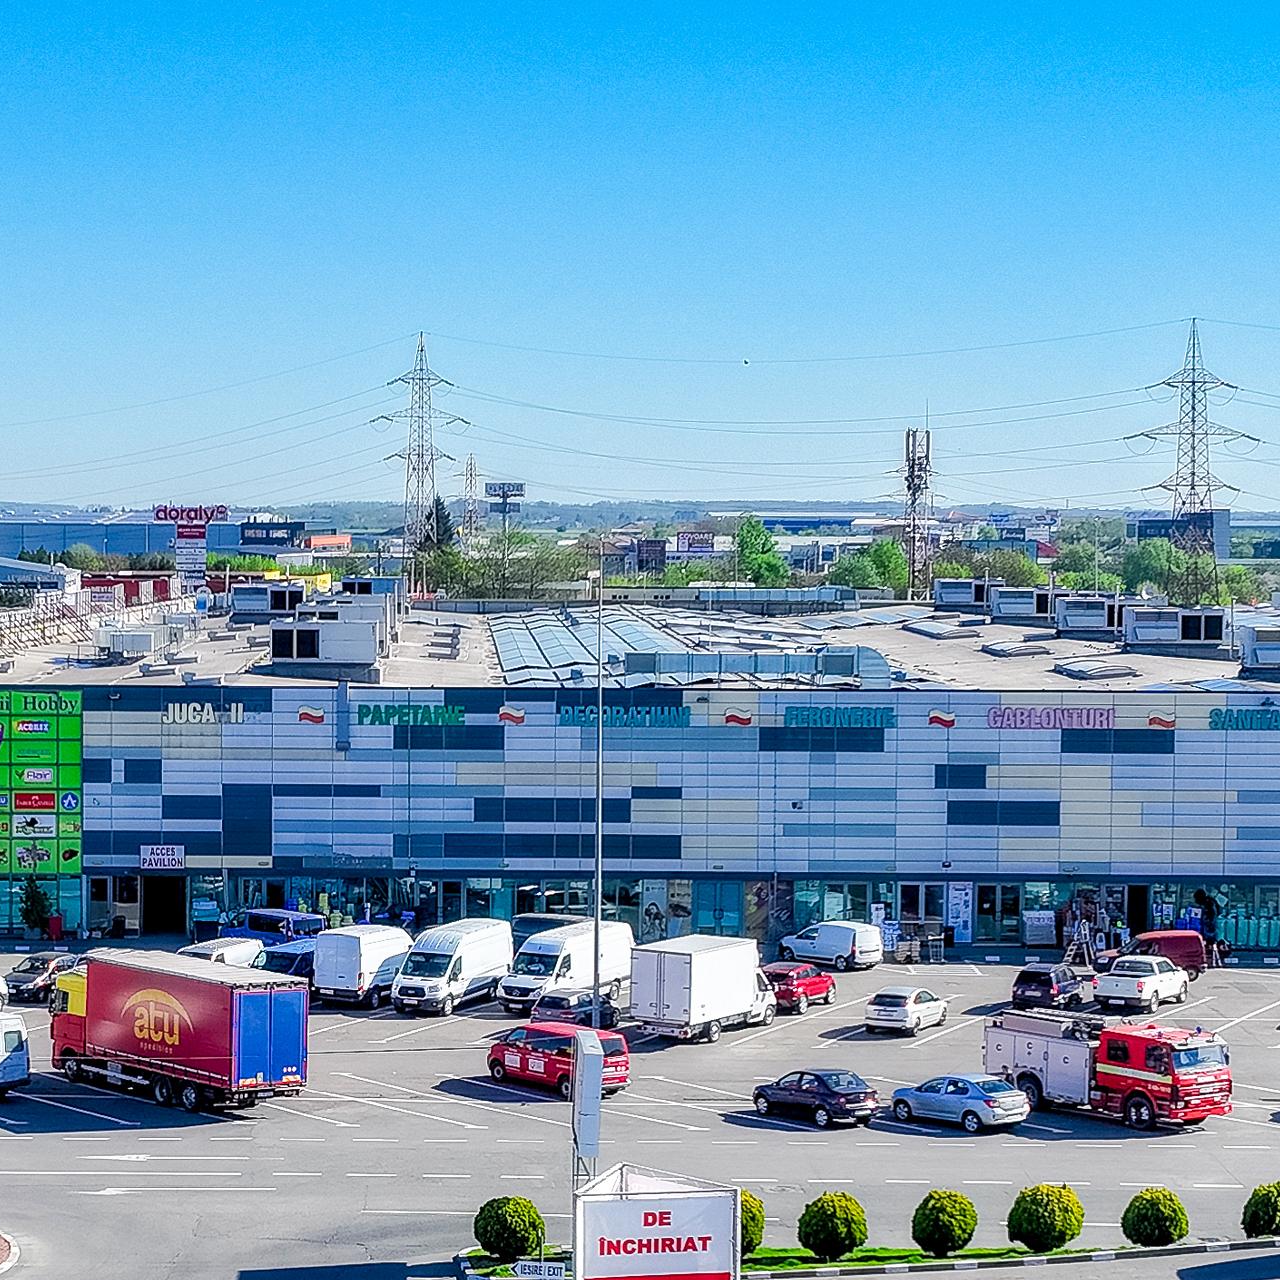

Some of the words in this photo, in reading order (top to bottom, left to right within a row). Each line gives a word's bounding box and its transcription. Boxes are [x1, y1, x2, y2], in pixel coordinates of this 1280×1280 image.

[155, 504, 216, 524] doraly
[23, 695, 78, 714] Hobby
[358, 703, 465, 726] PAPETARIE
[148, 846, 176, 857] ACCES
[142, 857, 184, 868] PAVILION
[134, 1001, 180, 1046] atu
[643, 1211, 672, 1228] DE
[598, 1236, 713, 1257] ÎNCHIRIAT
